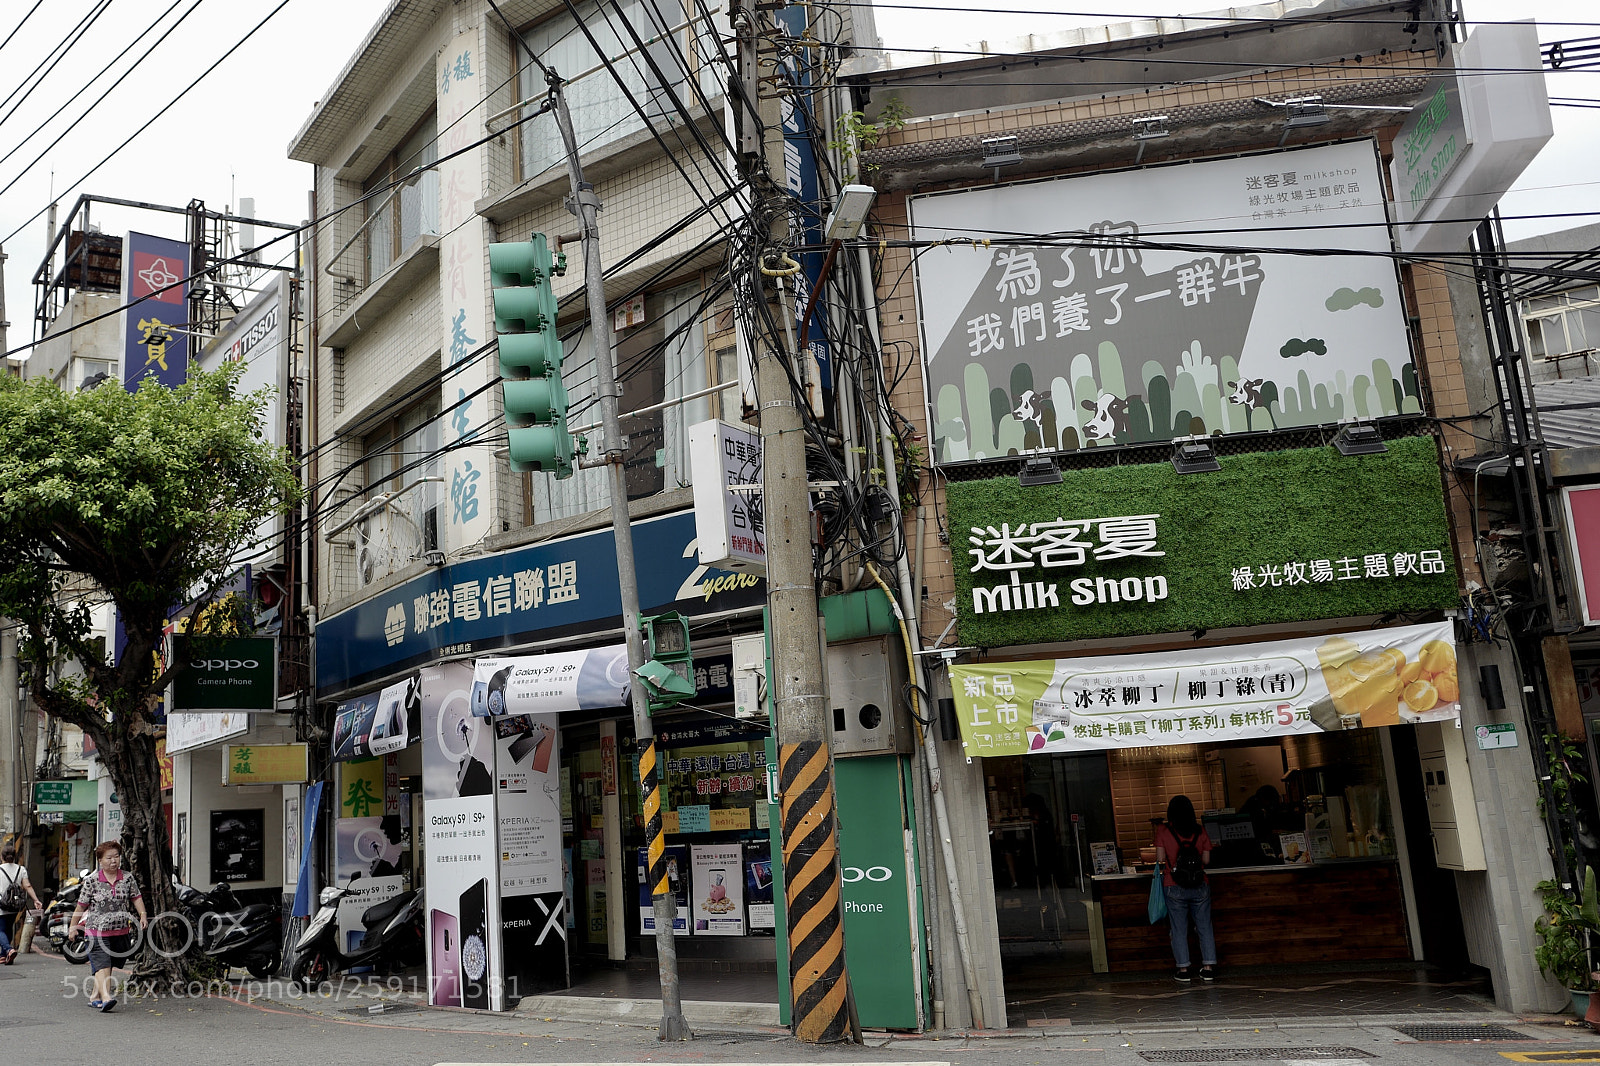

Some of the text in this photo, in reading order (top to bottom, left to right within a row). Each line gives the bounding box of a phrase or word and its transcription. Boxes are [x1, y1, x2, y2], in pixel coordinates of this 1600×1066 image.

[1245, 168, 1357, 190] 迷客夏 milkshop
[1249, 182, 1360, 206] 綠光牧場主題飲品
[995, 223, 1139, 303] 為了你
[967, 256, 1263, 357] 我們養了一群牛
[241, 305, 278, 354] TISSOT
[968, 513, 1166, 573] 迷客夏
[1231, 549, 1446, 591] 綠光牧場主題飲品
[413, 560, 580, 635] 聯強電信聯盟
[515, 667, 543, 677] Galaxy
[543, 665, 555, 674] S9
[963, 674, 1016, 698] 新品
[1073, 684, 1164, 708] 冰萃柳丁
[970, 701, 1018, 726] 上市
[667, 757, 691, 775] 中華
[695, 755, 720, 772] 遠傳
[724, 752, 750, 770] 台灣
[431, 812, 486, 828] Galaxy S9 S9+
[501, 817, 530, 825] XPERIA
[845, 900, 883, 913] Phone
[503, 919, 531, 928] XPERIA
